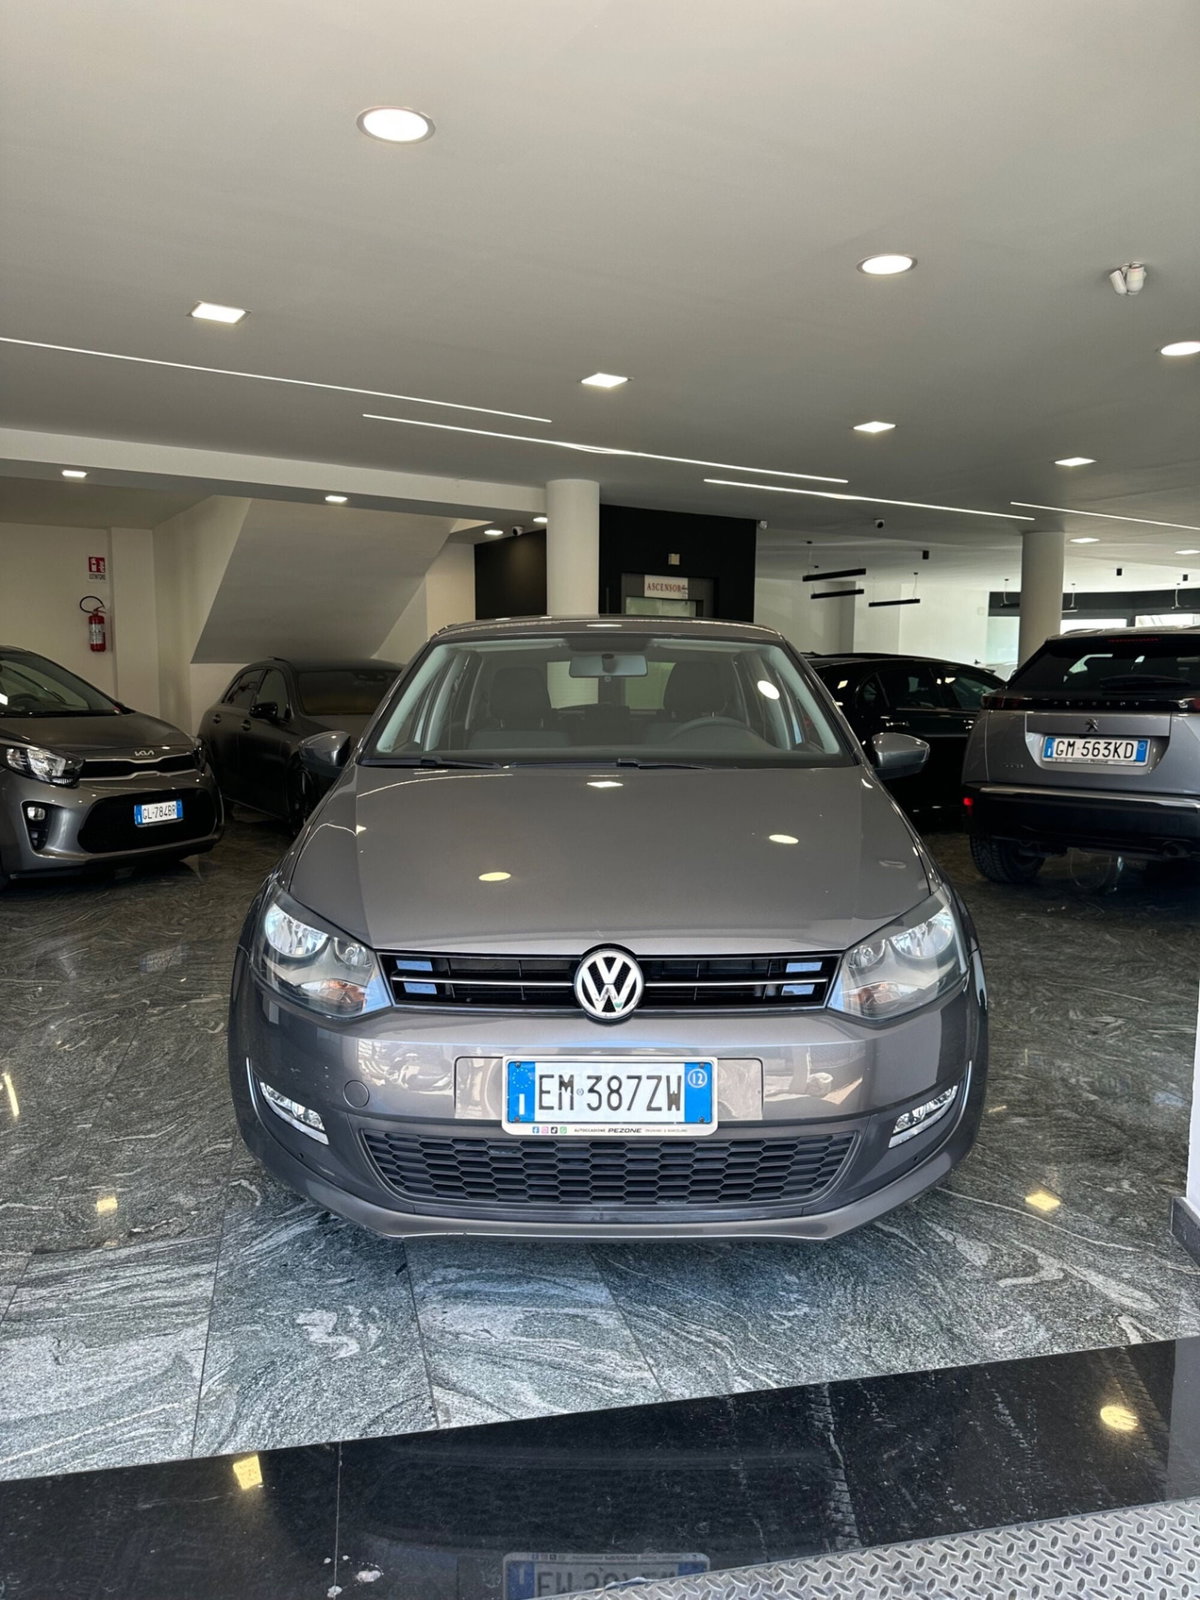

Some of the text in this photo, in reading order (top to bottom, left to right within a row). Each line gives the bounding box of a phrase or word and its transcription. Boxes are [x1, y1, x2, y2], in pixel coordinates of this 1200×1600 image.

[647, 582, 687, 592] ASCENSOR
[538, 1074, 575, 1111] EM
[586, 1075, 682, 1112] 387ZW
[690, 1074, 704, 1086] 12
